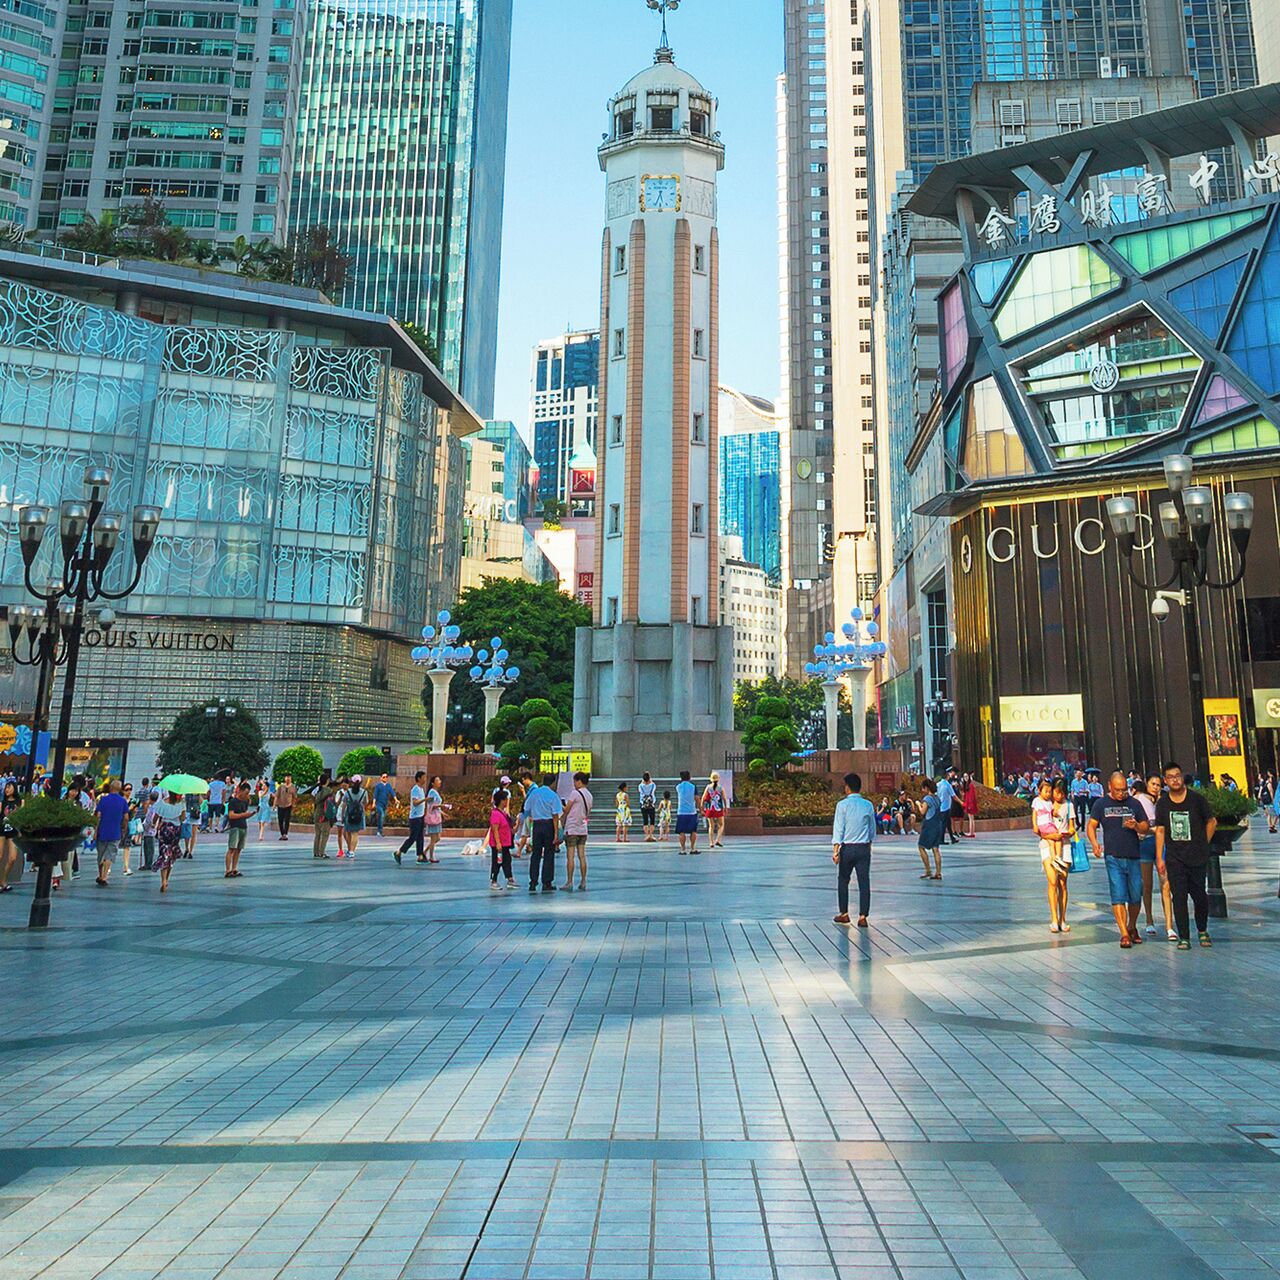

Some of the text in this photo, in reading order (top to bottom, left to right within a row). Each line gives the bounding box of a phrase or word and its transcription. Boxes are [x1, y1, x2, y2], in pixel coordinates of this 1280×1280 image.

[977, 152, 1280, 248] 金鹰财富中心
[81, 629, 235, 651] OUIS VUITTON
[1011, 706, 1071, 722] GUCCI
